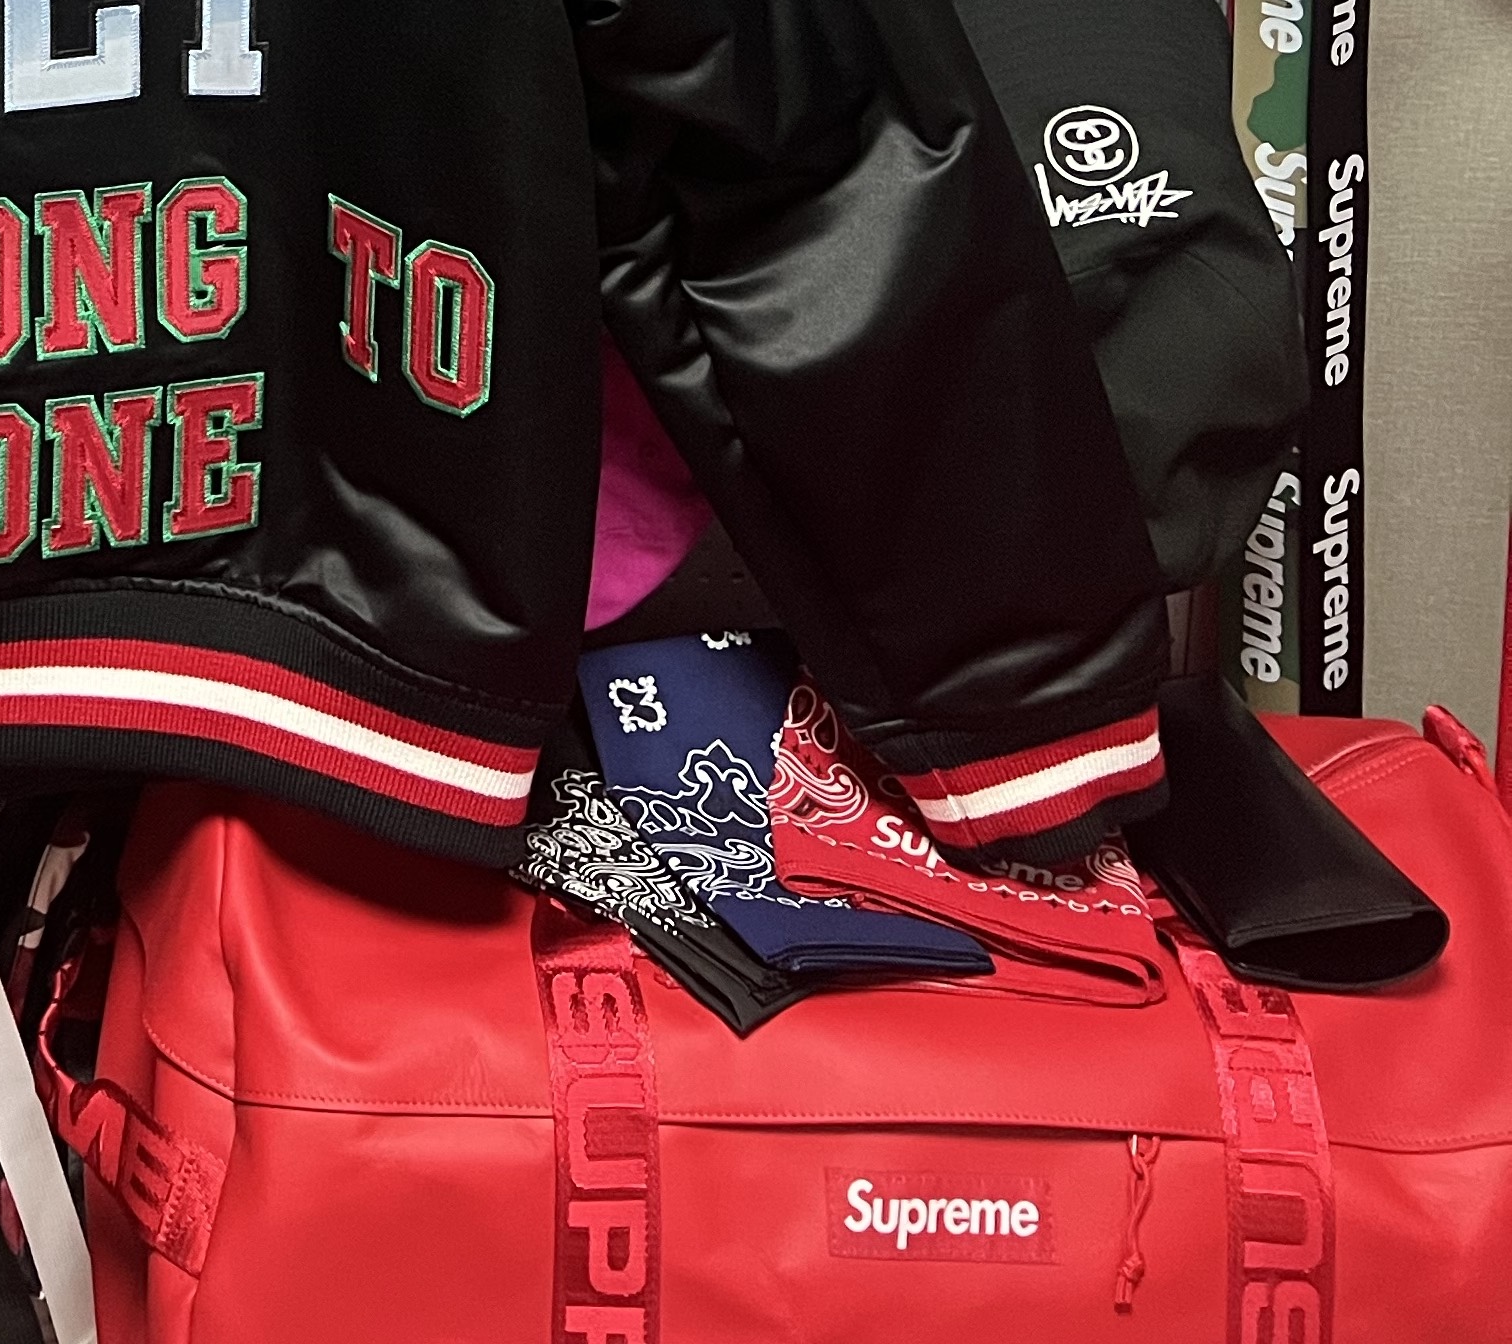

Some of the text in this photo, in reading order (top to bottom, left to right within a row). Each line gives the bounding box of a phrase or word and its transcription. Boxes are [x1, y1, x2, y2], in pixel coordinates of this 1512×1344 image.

[327, 192, 495, 416] TO
[1319, 154, 1365, 387] Supreme
[1313, 468, 1360, 691] Supreme
[843, 1179, 1039, 1250] Supreme
